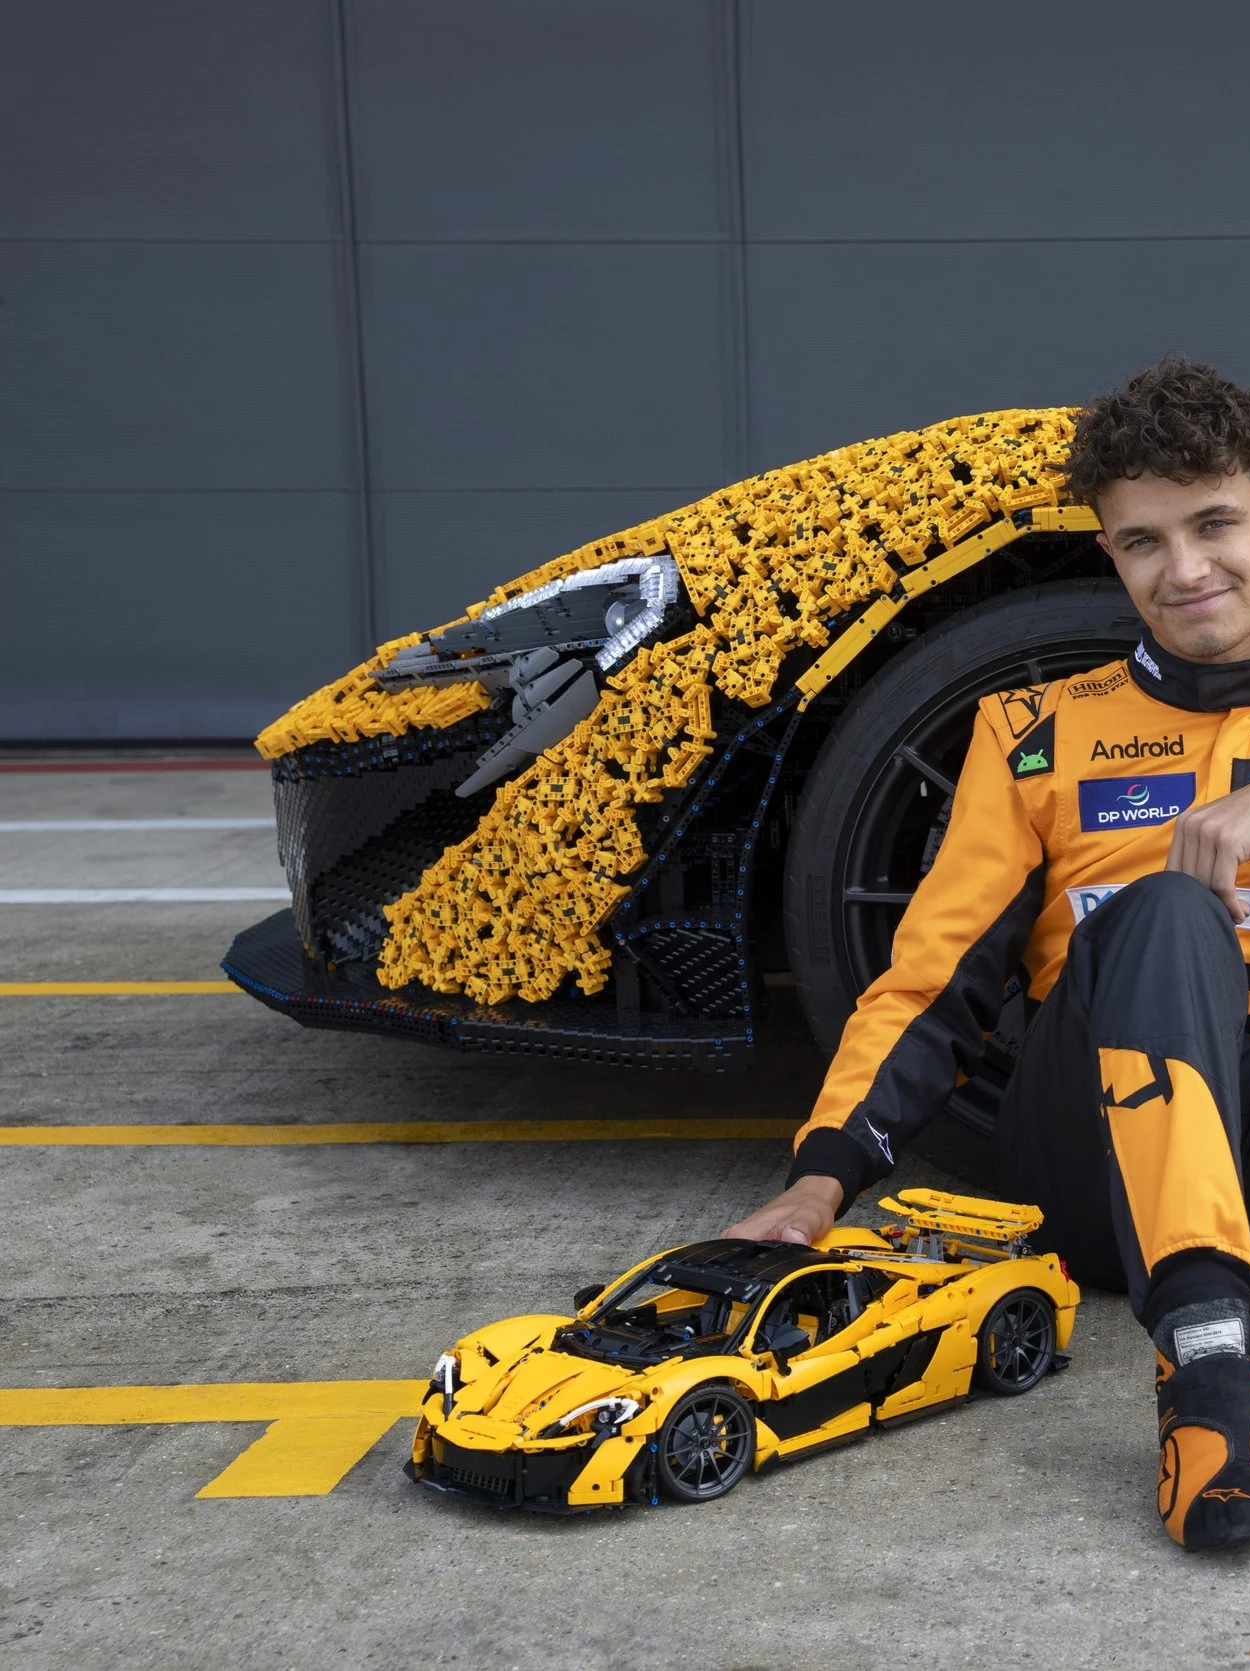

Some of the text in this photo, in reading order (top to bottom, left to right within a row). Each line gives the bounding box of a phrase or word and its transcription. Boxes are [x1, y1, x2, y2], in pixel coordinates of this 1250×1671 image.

[1073, 673, 1123, 693] Hilton
[1111, 679, 1129, 692] STAY
[1090, 734, 1185, 761] Android
[1098, 805, 1180, 823] DP WORLD
